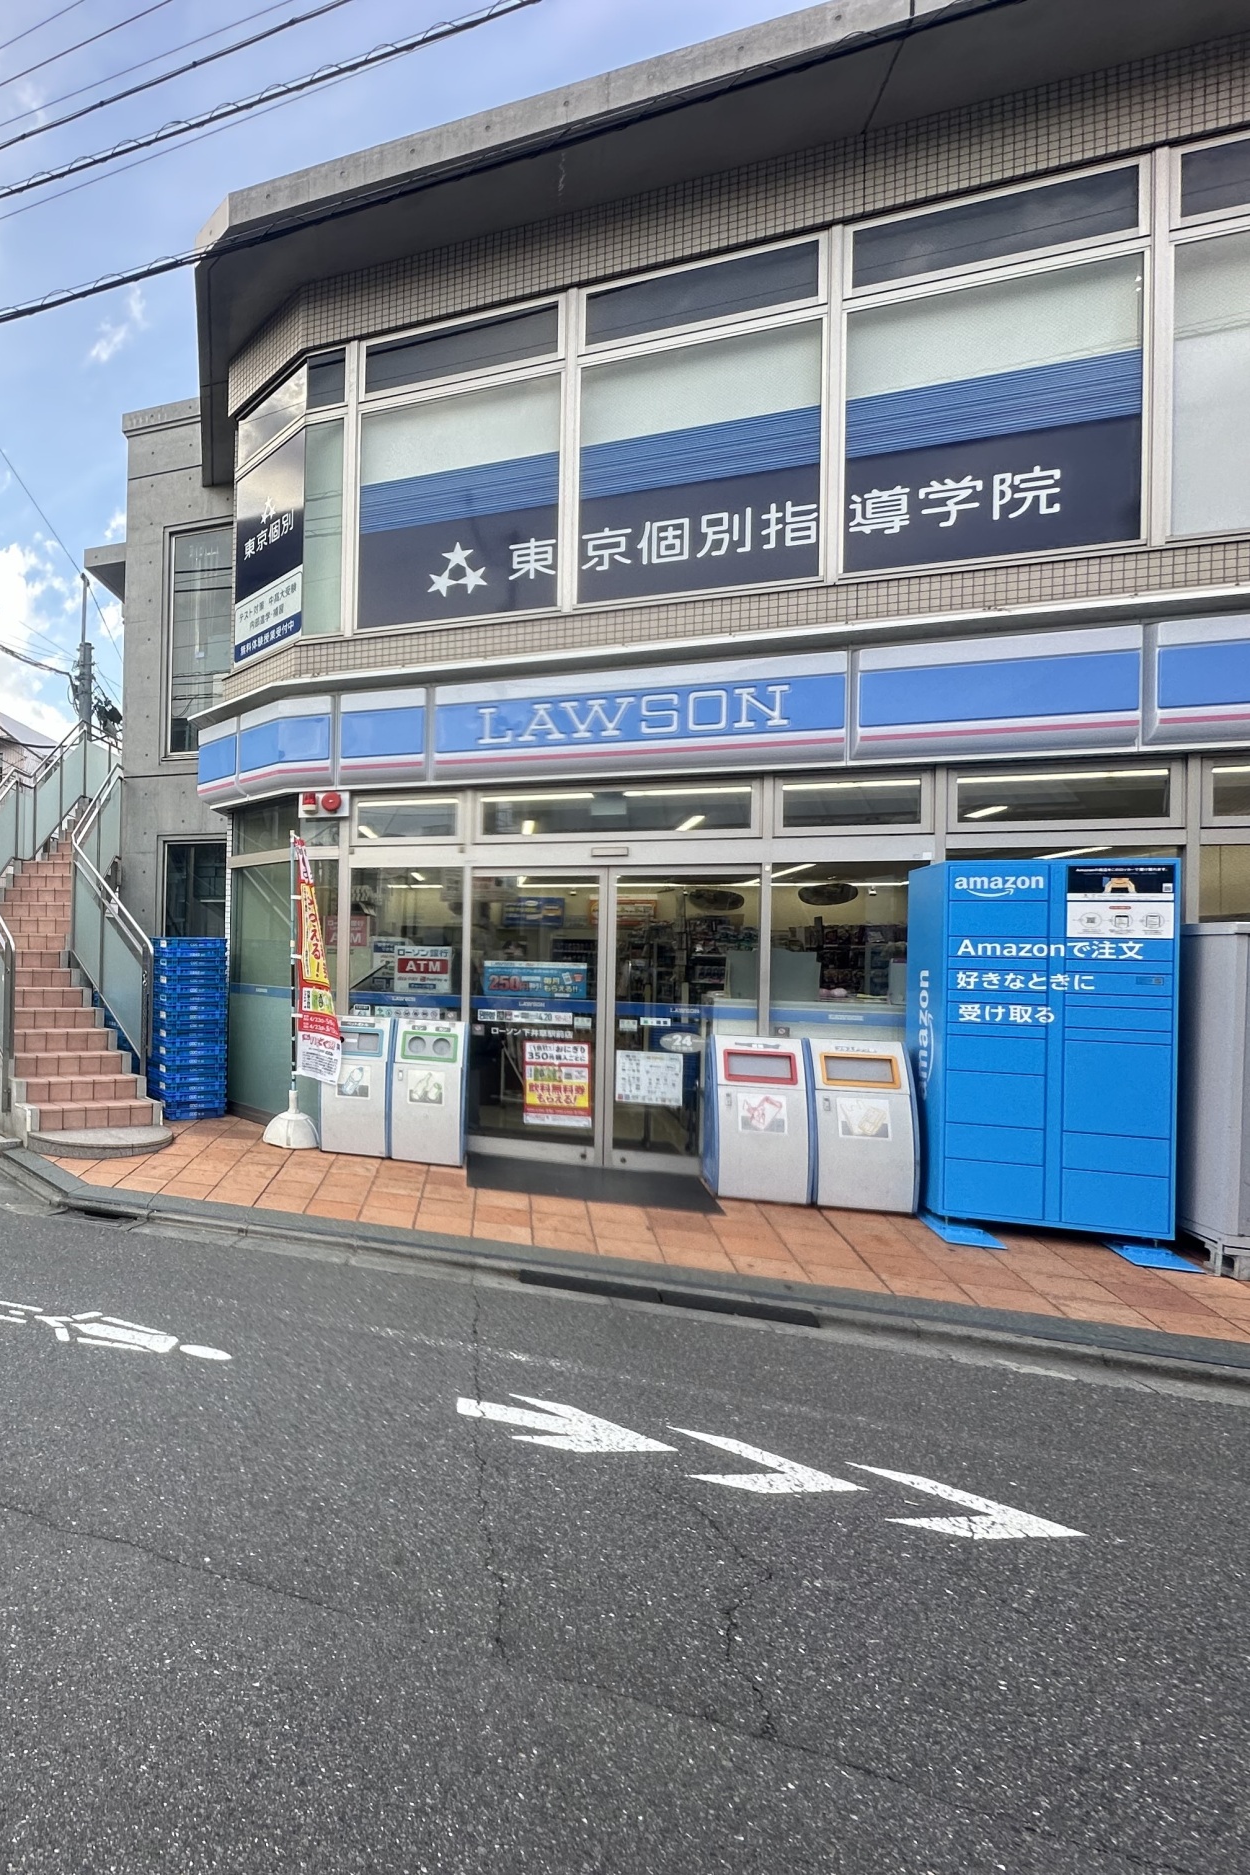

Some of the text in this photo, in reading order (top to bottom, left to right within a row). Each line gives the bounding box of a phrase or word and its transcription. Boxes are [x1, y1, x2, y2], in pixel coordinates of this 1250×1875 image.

[508, 465, 1062, 581] 東京個別指導学院
[244, 509, 294, 560] 東京個別
[240, 620, 295, 657] 無料体験授業受付中
[477, 684, 791, 745] LAWSON
[955, 876, 1044, 891] amazon
[330, 932, 362, 943] AM
[397, 948, 449, 958] ローソン銀行
[956, 939, 1144, 960] Amazonで注文
[405, 960, 442, 972] ATM
[956, 971, 1096, 991] 好きなときに
[958, 1004, 1055, 1023] 受け取る
[672, 1034, 692, 1046] 24
[918, 969, 931, 1101] amazon
[528, 1052, 586, 1062] 350円購入ごとに
[555, 1045, 586, 1053] おにぎり
[537, 1094, 577, 1105] もらえる!
